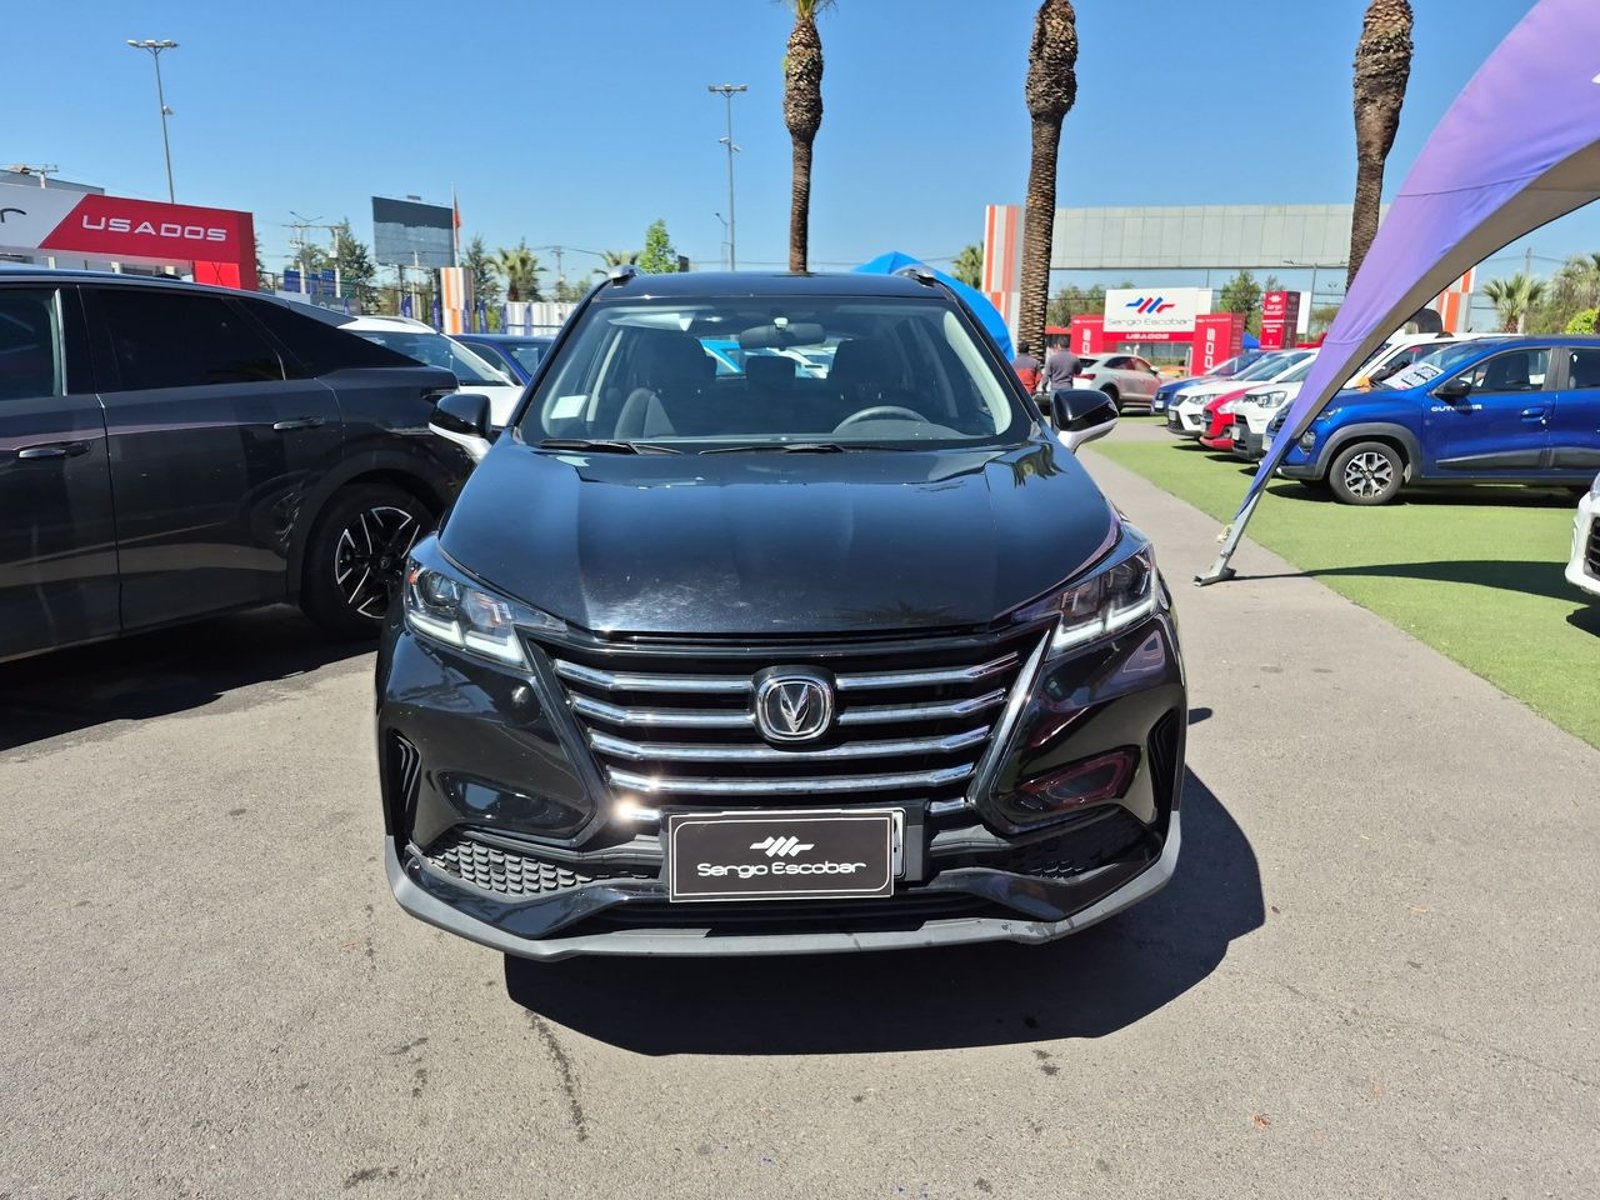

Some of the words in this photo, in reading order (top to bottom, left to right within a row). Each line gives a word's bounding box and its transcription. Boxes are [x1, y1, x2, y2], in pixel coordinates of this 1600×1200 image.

[82, 214, 228, 242] USADOS
[697, 863, 768, 879] Sergio
[771, 861, 867, 875] Escobar
